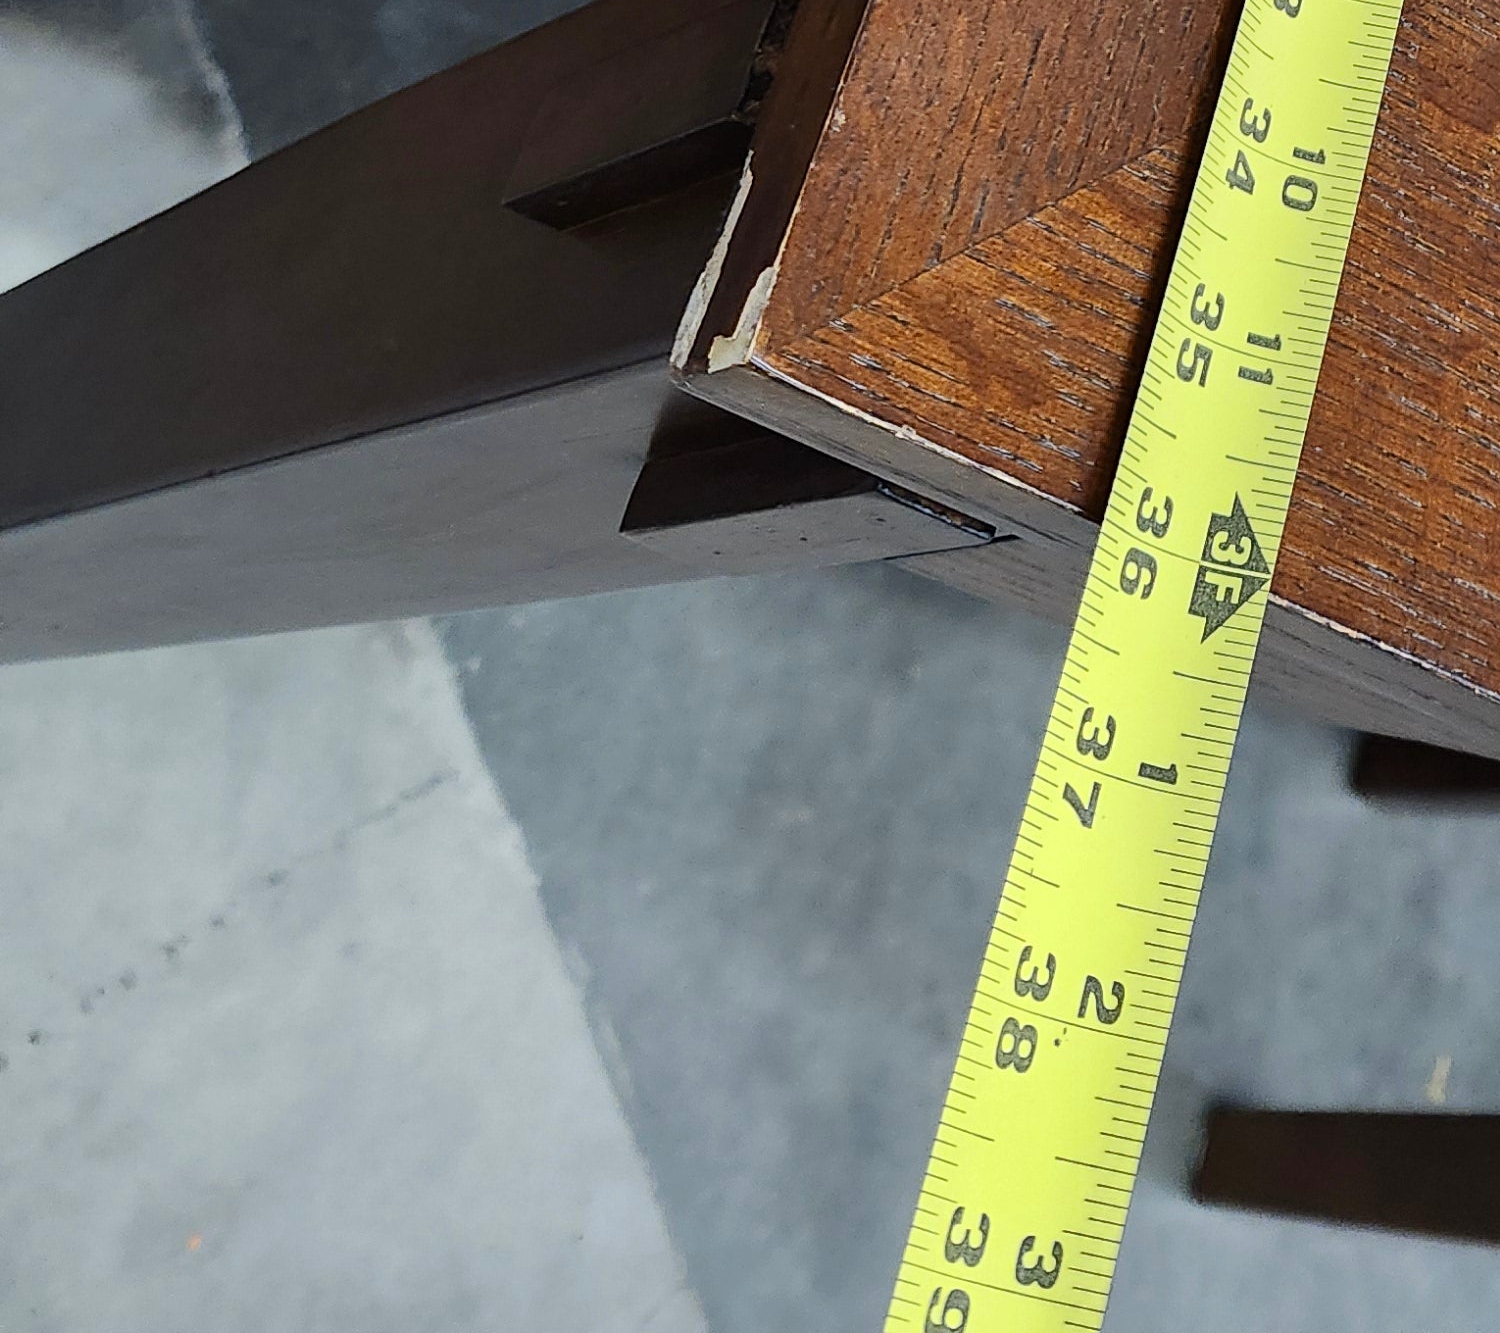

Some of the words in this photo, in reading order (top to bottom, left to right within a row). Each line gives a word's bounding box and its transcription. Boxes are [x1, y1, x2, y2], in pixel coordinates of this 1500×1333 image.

[1226, 97, 1272, 196] 34
[1282, 145, 1327, 213] 10
[1176, 282, 1225, 389] 35
[1237, 331, 1282, 387] 11
[1119, 485, 1175, 601] 36
[1200, 530, 1252, 606] 3F
[1062, 706, 1117, 829] 37
[1139, 761, 1178, 785] 1
[995, 945, 1056, 1074] 38
[1077, 975, 1126, 1026] 2
[924, 1205, 991, 1333] 39
[1015, 1234, 1065, 1291] 3
